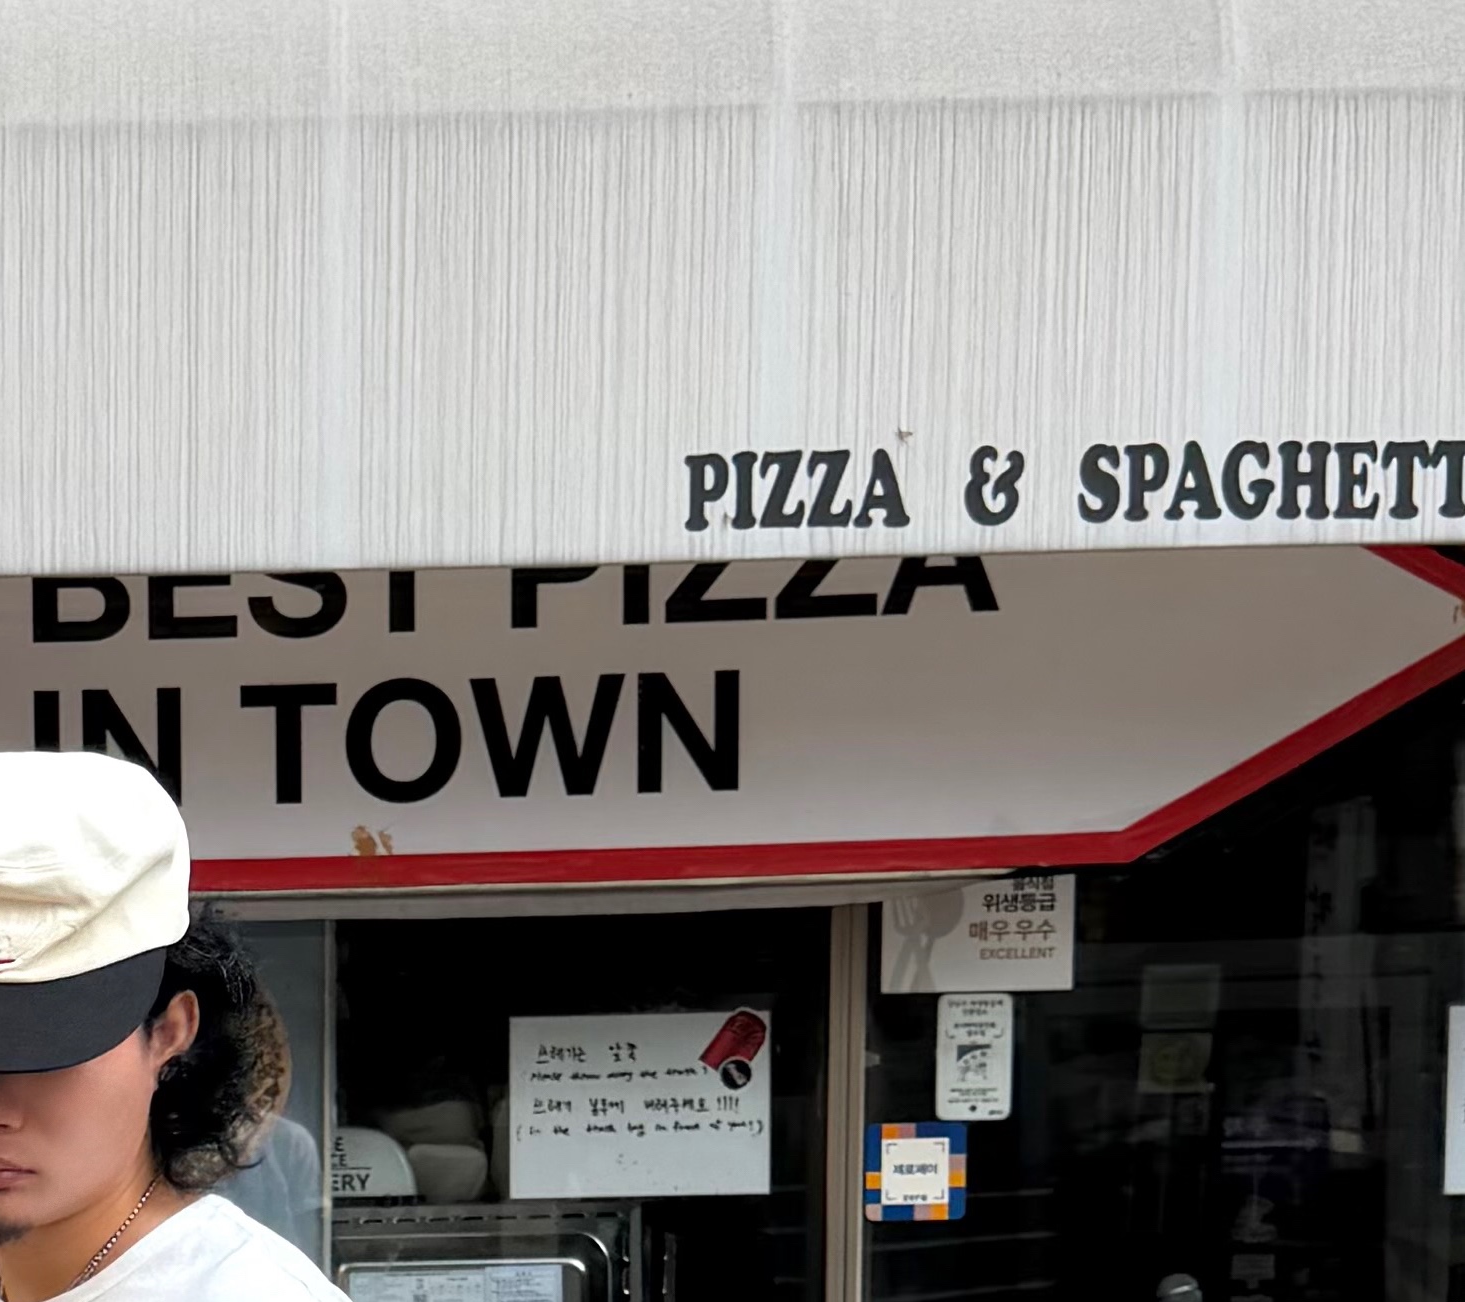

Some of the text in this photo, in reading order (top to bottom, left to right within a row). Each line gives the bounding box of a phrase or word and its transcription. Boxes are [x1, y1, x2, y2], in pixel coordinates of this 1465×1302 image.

[684, 439, 1465, 532] PIZZA & SPAGHETT
[33, 669, 741, 806] IN TOWN
[982, 893, 1056, 913] 위생등급
[969, 920, 1057, 941] 매우 우수
[980, 946, 1056, 960] EXCELLENT
